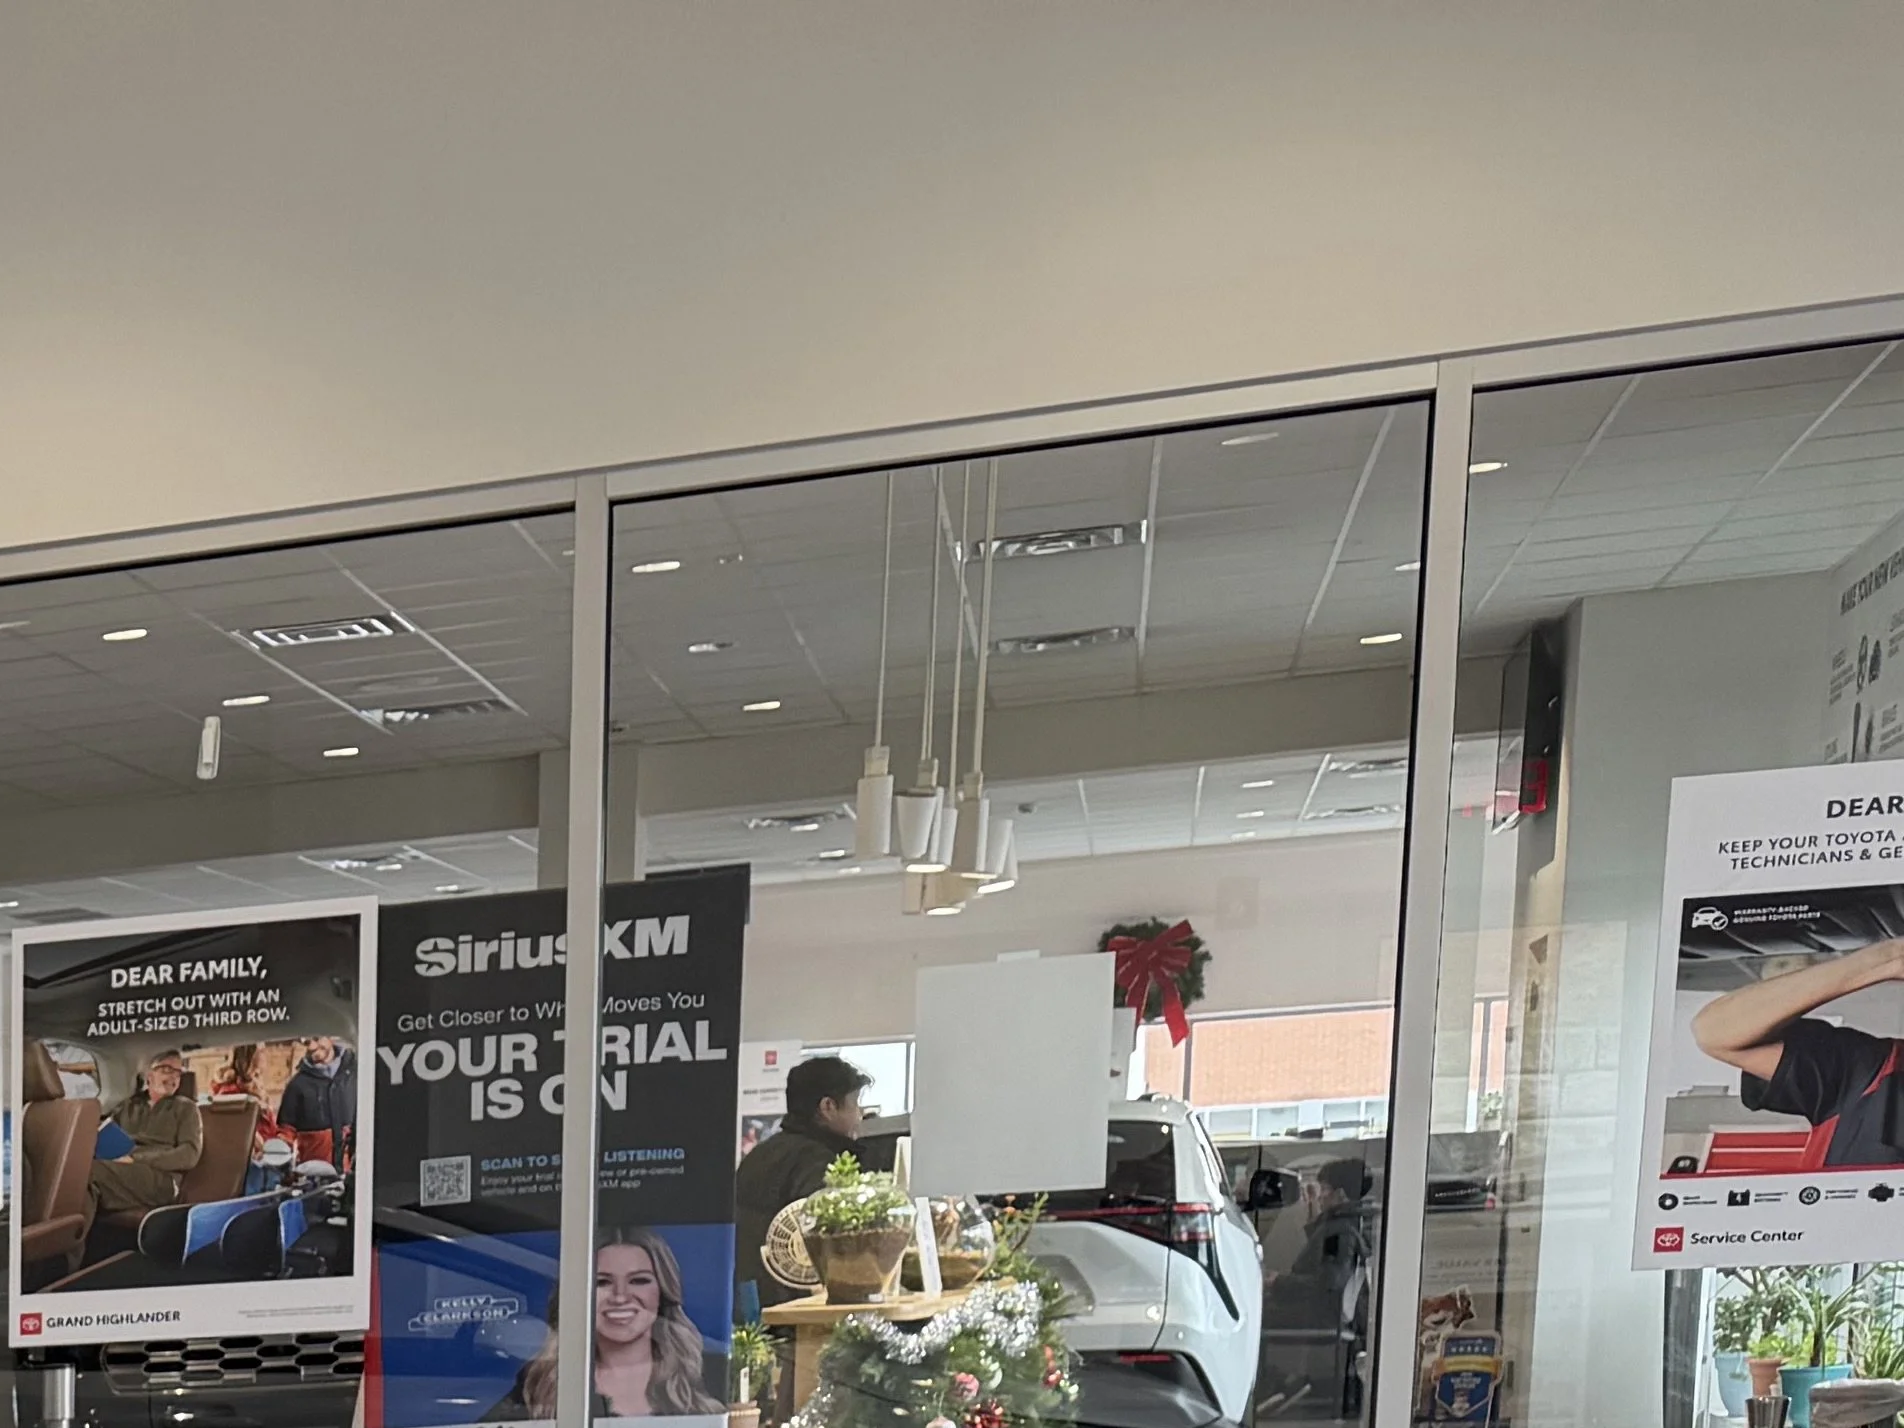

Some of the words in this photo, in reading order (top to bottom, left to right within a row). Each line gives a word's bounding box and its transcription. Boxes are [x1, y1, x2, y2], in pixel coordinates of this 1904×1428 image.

[1826, 795, 1904, 819] DEAR
[1718, 839, 1763, 855] KEEP
[1769, 835, 1818, 851] YOUR
[1825, 829, 1896, 847] TOYOTA
[1730, 850, 1854, 870] TECHNICIANS
[1859, 848, 1872, 860] &
[110, 963, 174, 989] DEAR
[179, 955, 268, 983] FAMILY,
[98, 997, 167, 1018] STRETCH
[171, 994, 206, 1011] OUT
[209, 990, 252, 1008] WITH
[255, 987, 281, 1004] AN
[397, 1013, 434, 1033] Get
[439, 1006, 502, 1028] Closer
[510, 1004, 529, 1022] to
[668, 990, 706, 1010] You
[86, 1015, 190, 1037] ADULT-SIZED
[193, 1010, 243, 1028] THIRD
[246, 1006, 291, 1024] ROW.
[377, 1033, 538, 1086] YOUR
[470, 1077, 525, 1122] IS
[480, 1156, 524, 1172] SCAN
[528, 1154, 549, 1168] TO
[603, 1147, 686, 1164] LISTENING
[1690, 1231, 1747, 1245] Service
[1750, 1229, 1805, 1243] Center
[45, 1315, 93, 1329] GRAND
[95, 1310, 181, 1327] HIGHLANDER
